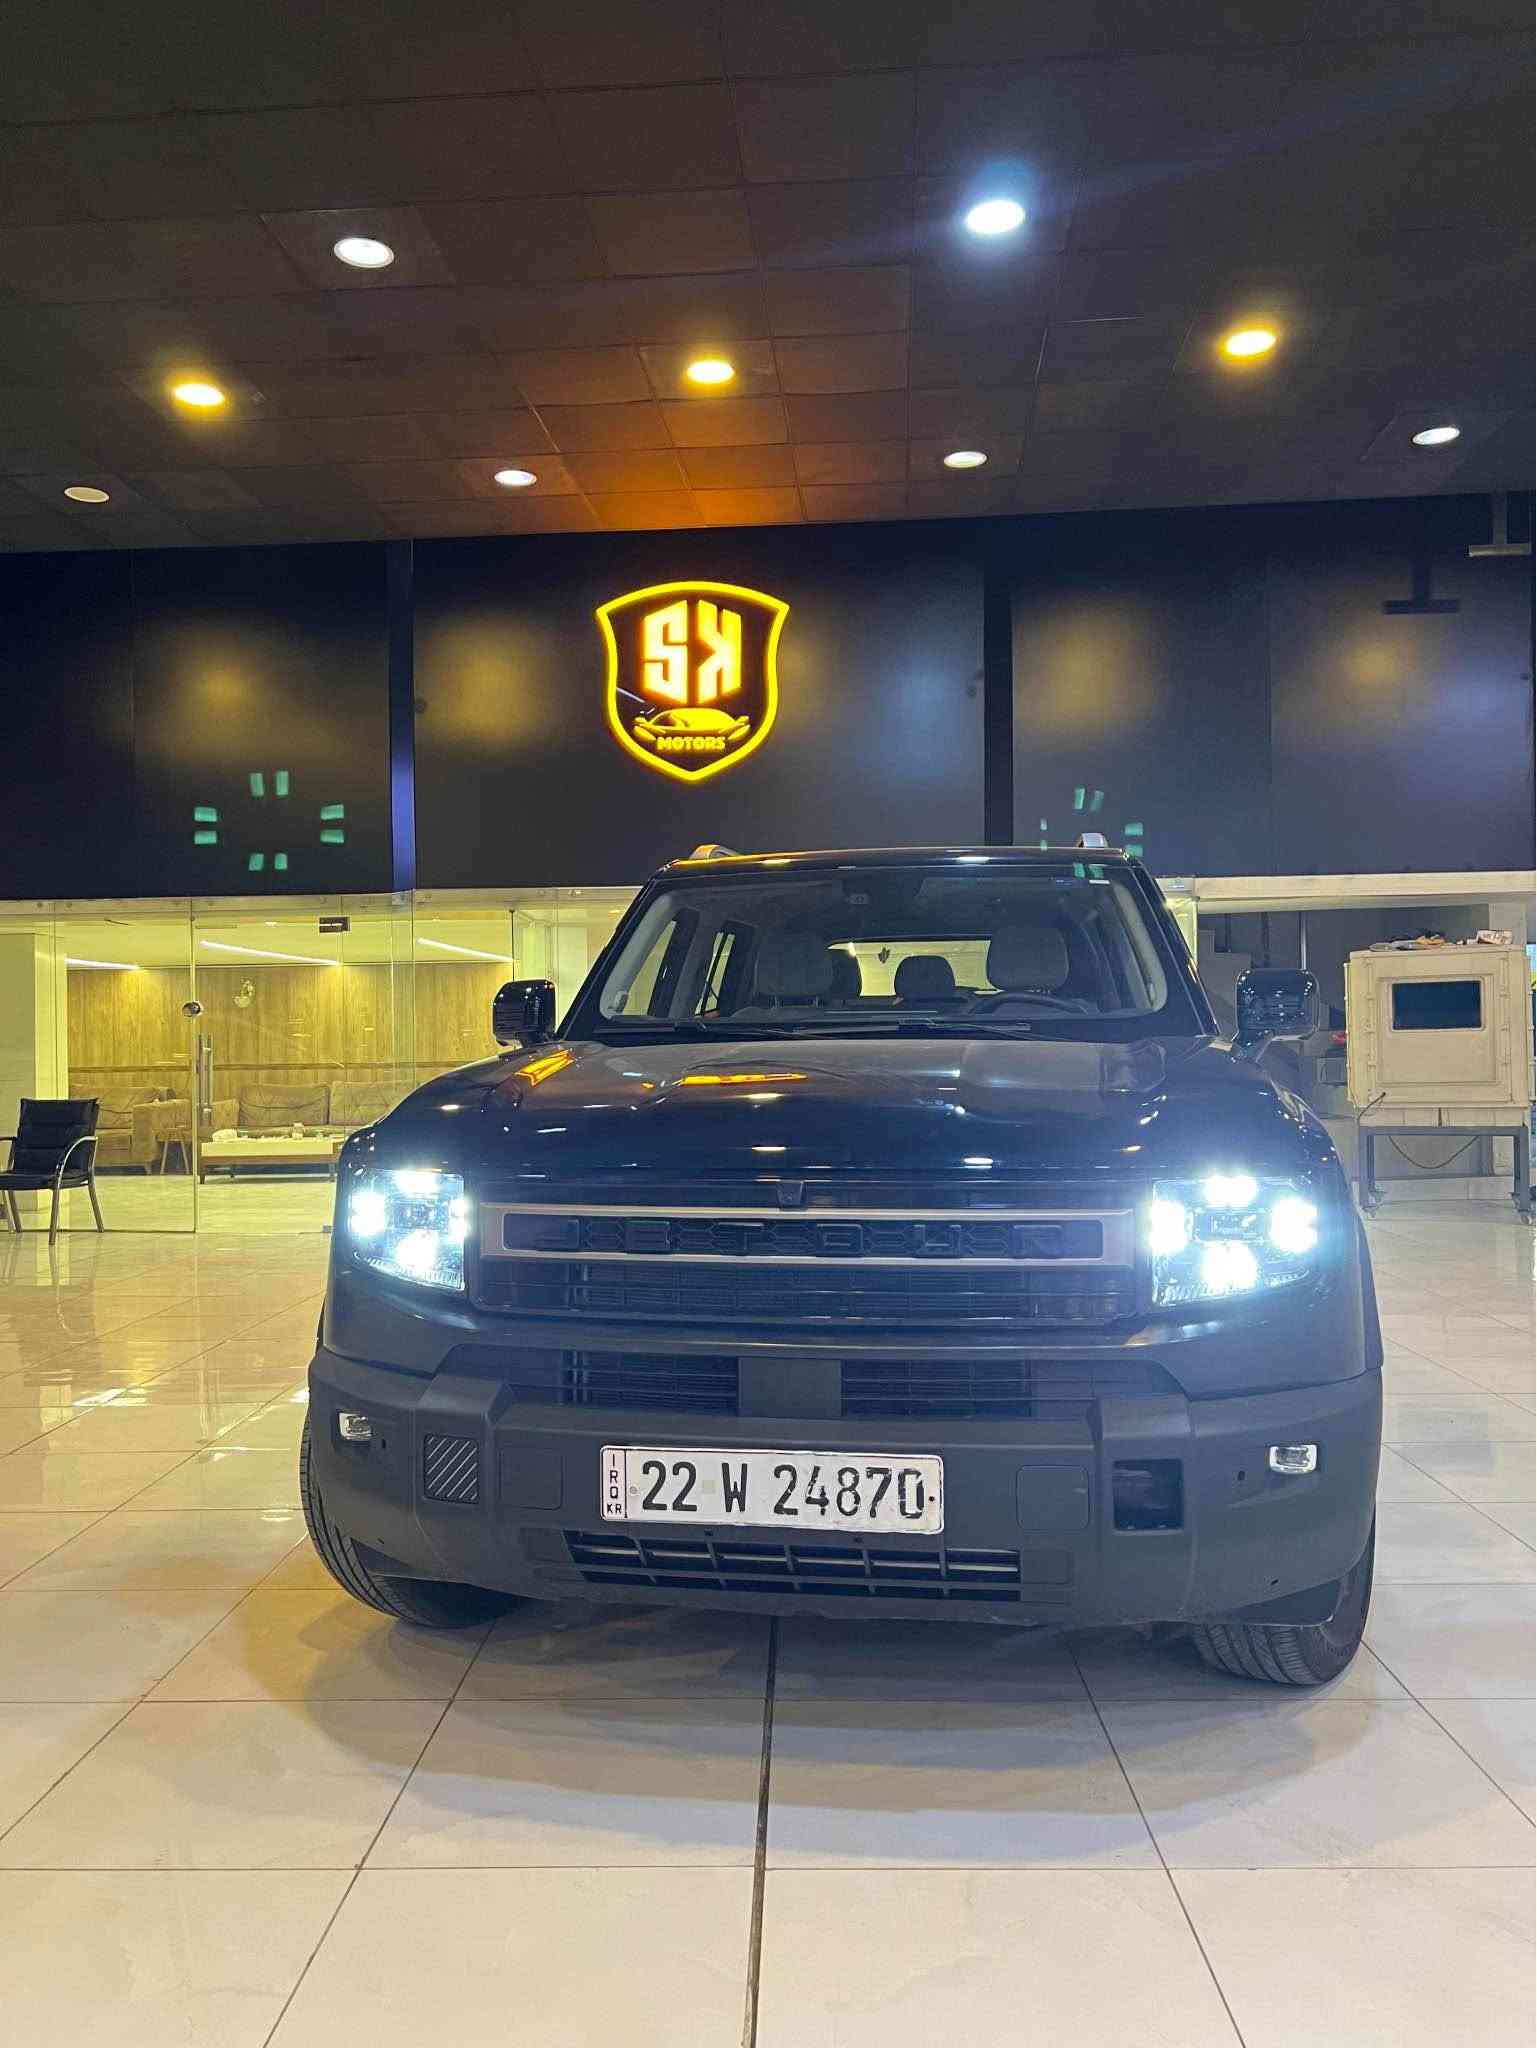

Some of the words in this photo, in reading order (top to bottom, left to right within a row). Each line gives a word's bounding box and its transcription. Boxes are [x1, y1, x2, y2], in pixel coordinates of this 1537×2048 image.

[642, 598, 742, 704] SK
[656, 735, 726, 751] MOTORS
[641, 1460, 698, 1512] 22
[721, 1462, 748, 1513] W
[773, 1463, 925, 1519] 24870
